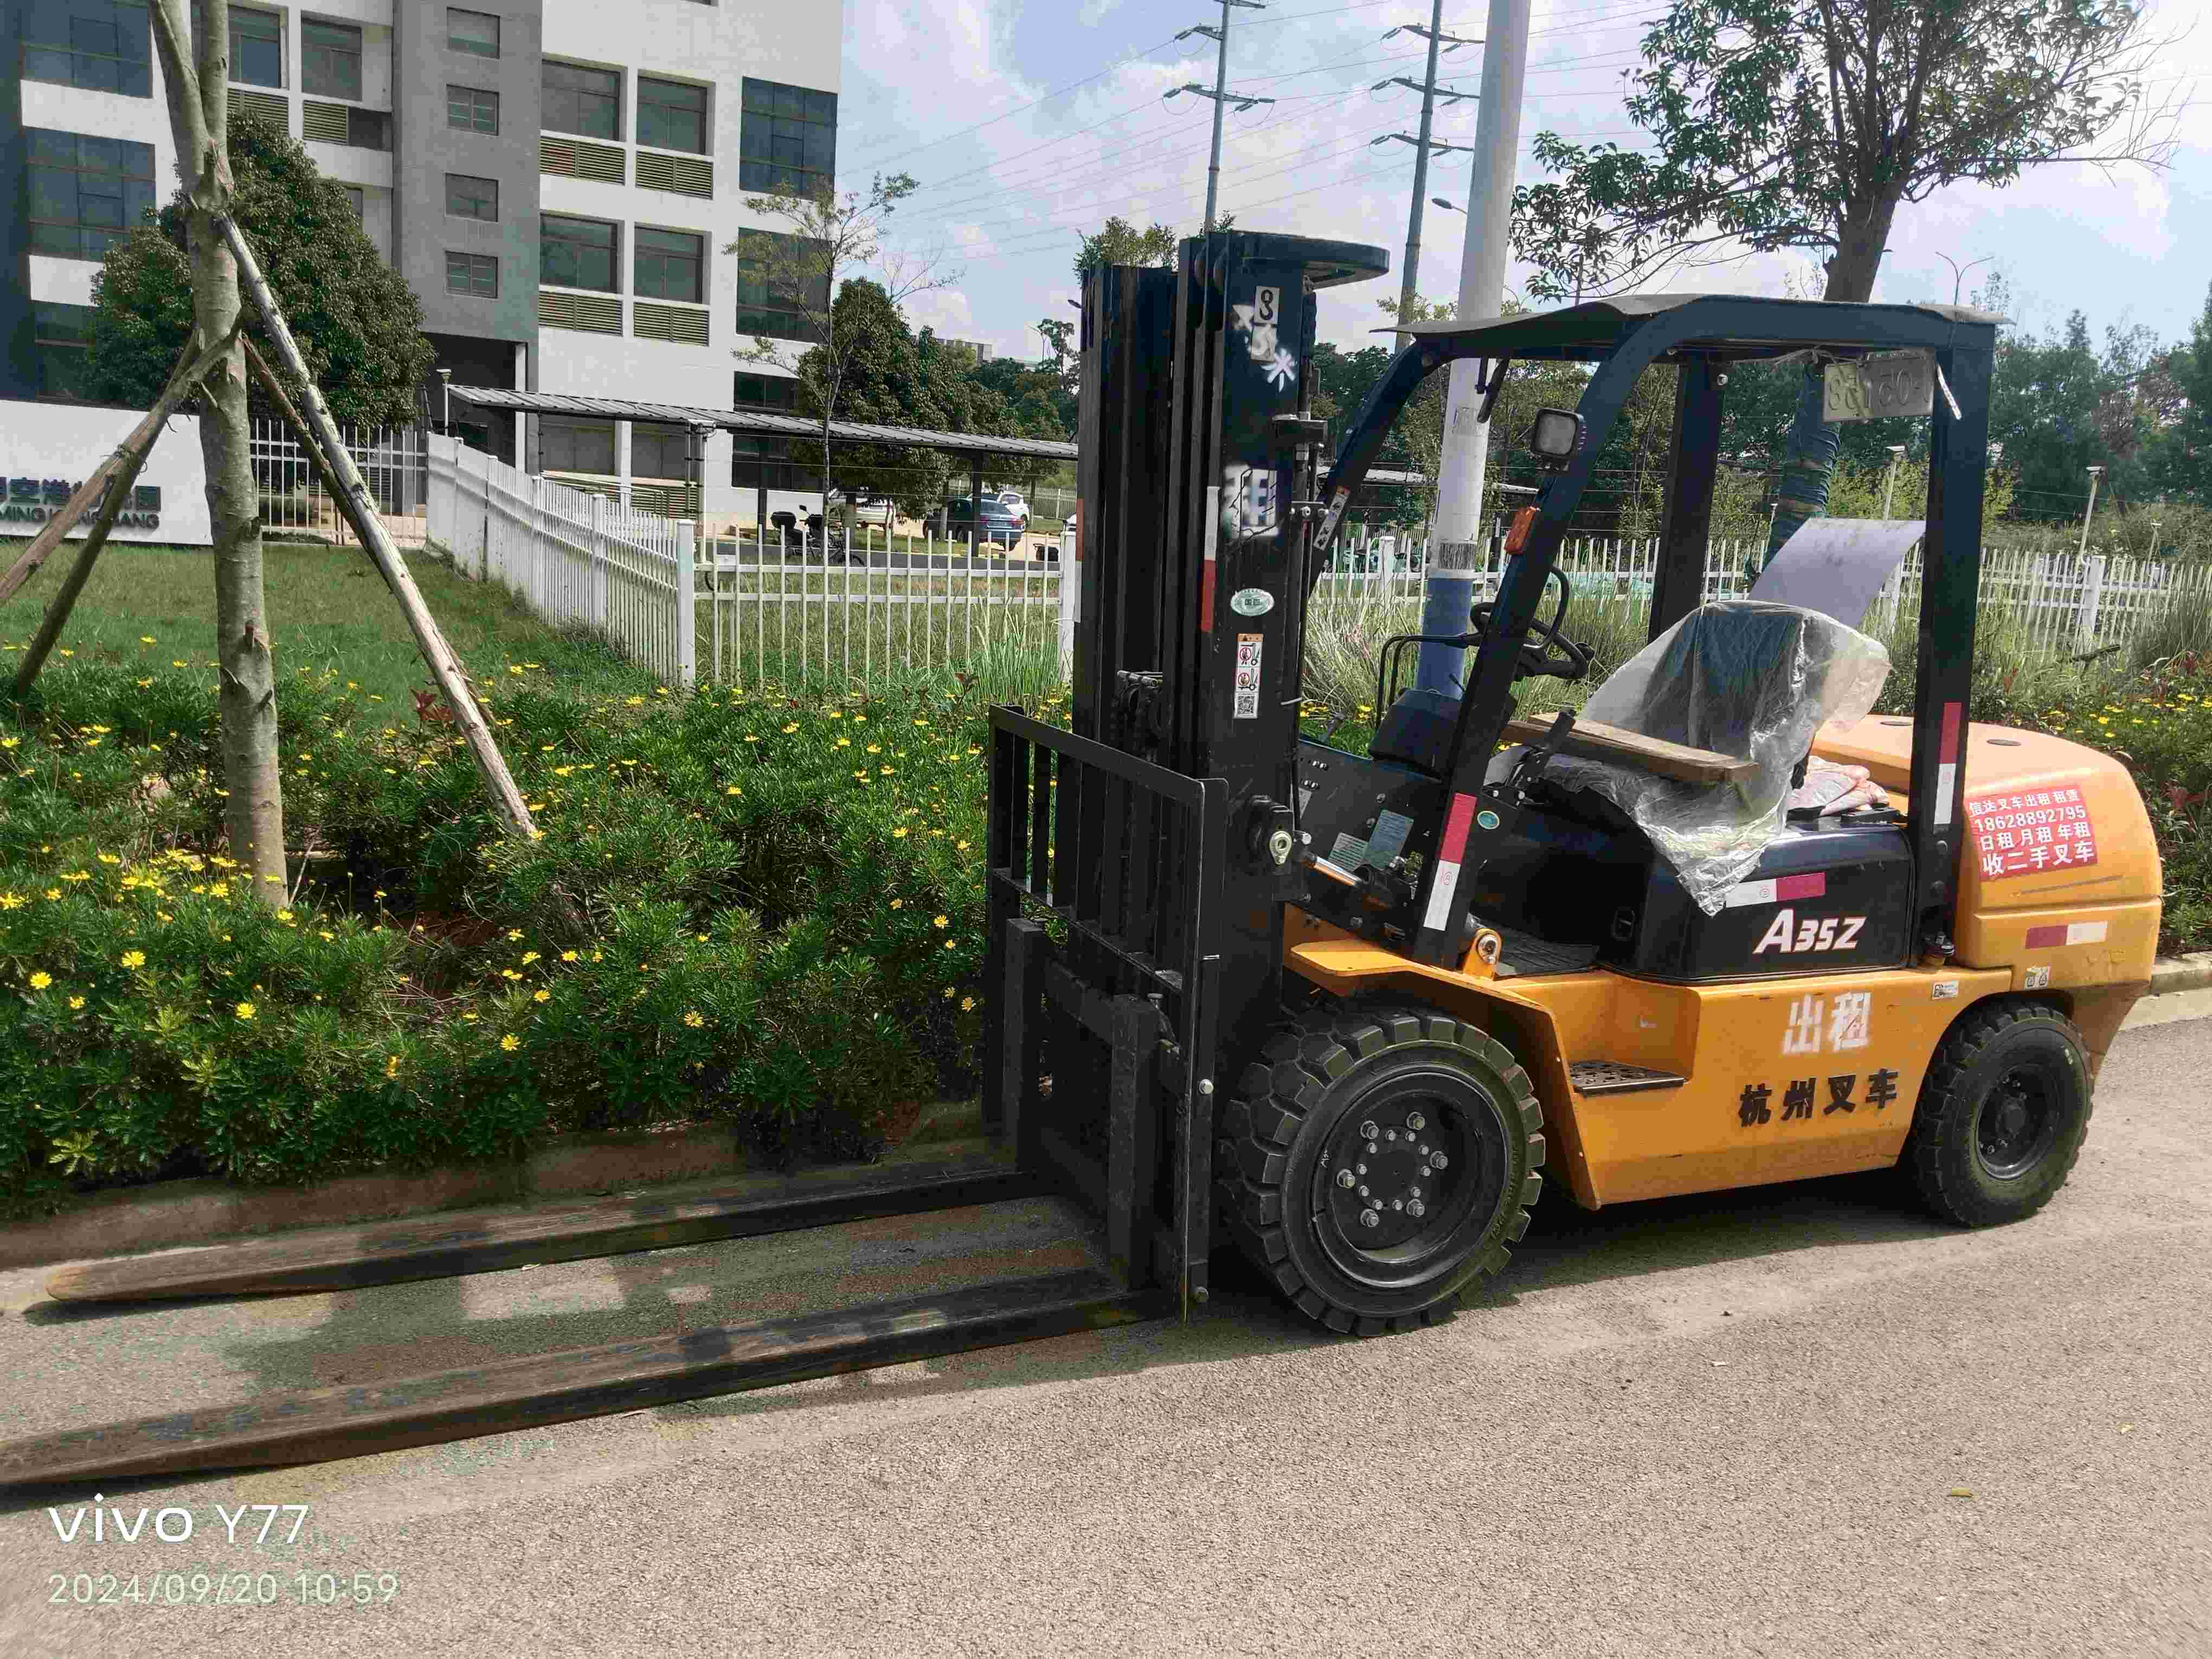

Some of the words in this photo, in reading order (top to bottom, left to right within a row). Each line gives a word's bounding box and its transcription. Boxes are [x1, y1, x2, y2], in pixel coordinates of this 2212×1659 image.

[1975, 805, 2086, 832] 18628892795
[1983, 841, 2094, 876] 收二手叉车
[1752, 908, 1867, 954] A35Z
[1782, 991, 1872, 1054] 出租
[1738, 1068, 1900, 1127] 杭州叉车
